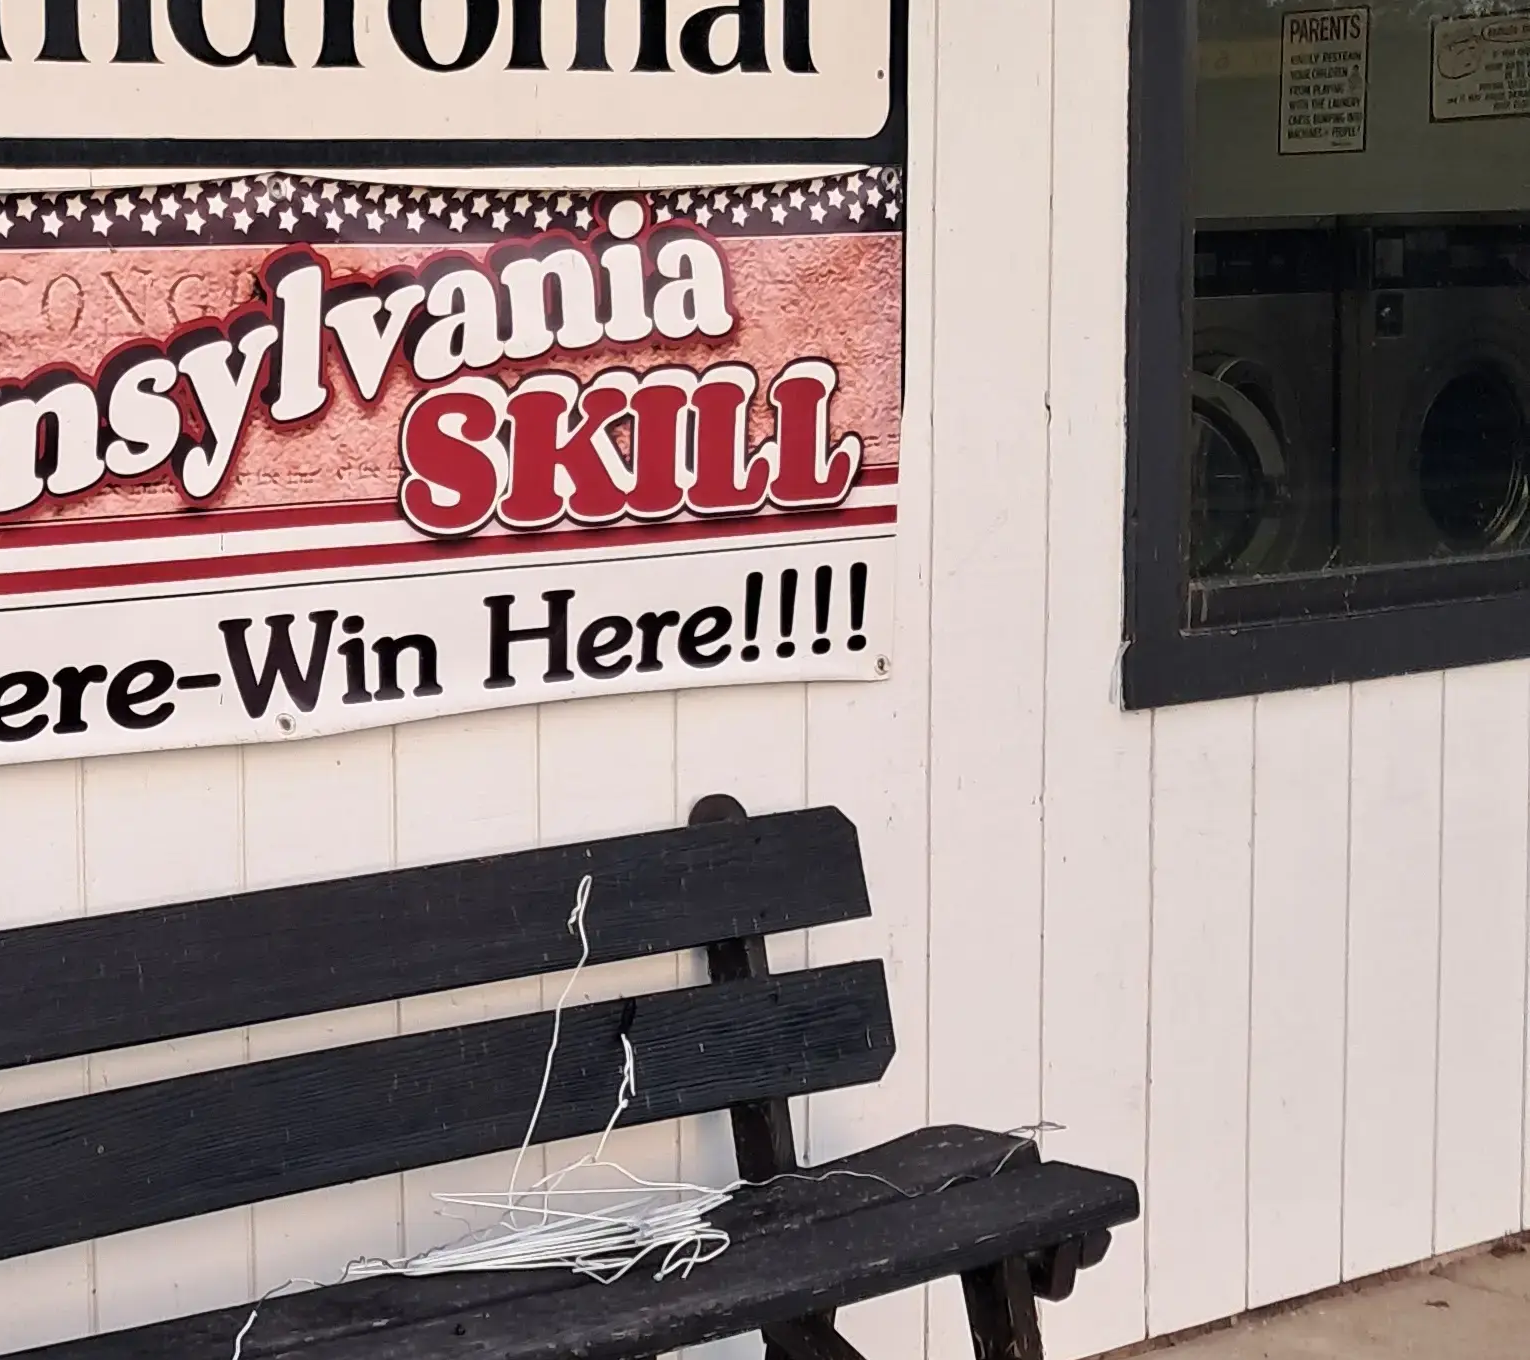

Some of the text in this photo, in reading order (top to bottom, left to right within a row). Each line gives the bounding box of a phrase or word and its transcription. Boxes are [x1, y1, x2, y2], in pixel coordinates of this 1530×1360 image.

[1290, 14, 1361, 43] PARENTS
[400, 360, 862, 536] SKILL
[482, 561, 868, 691] Here!!!!
